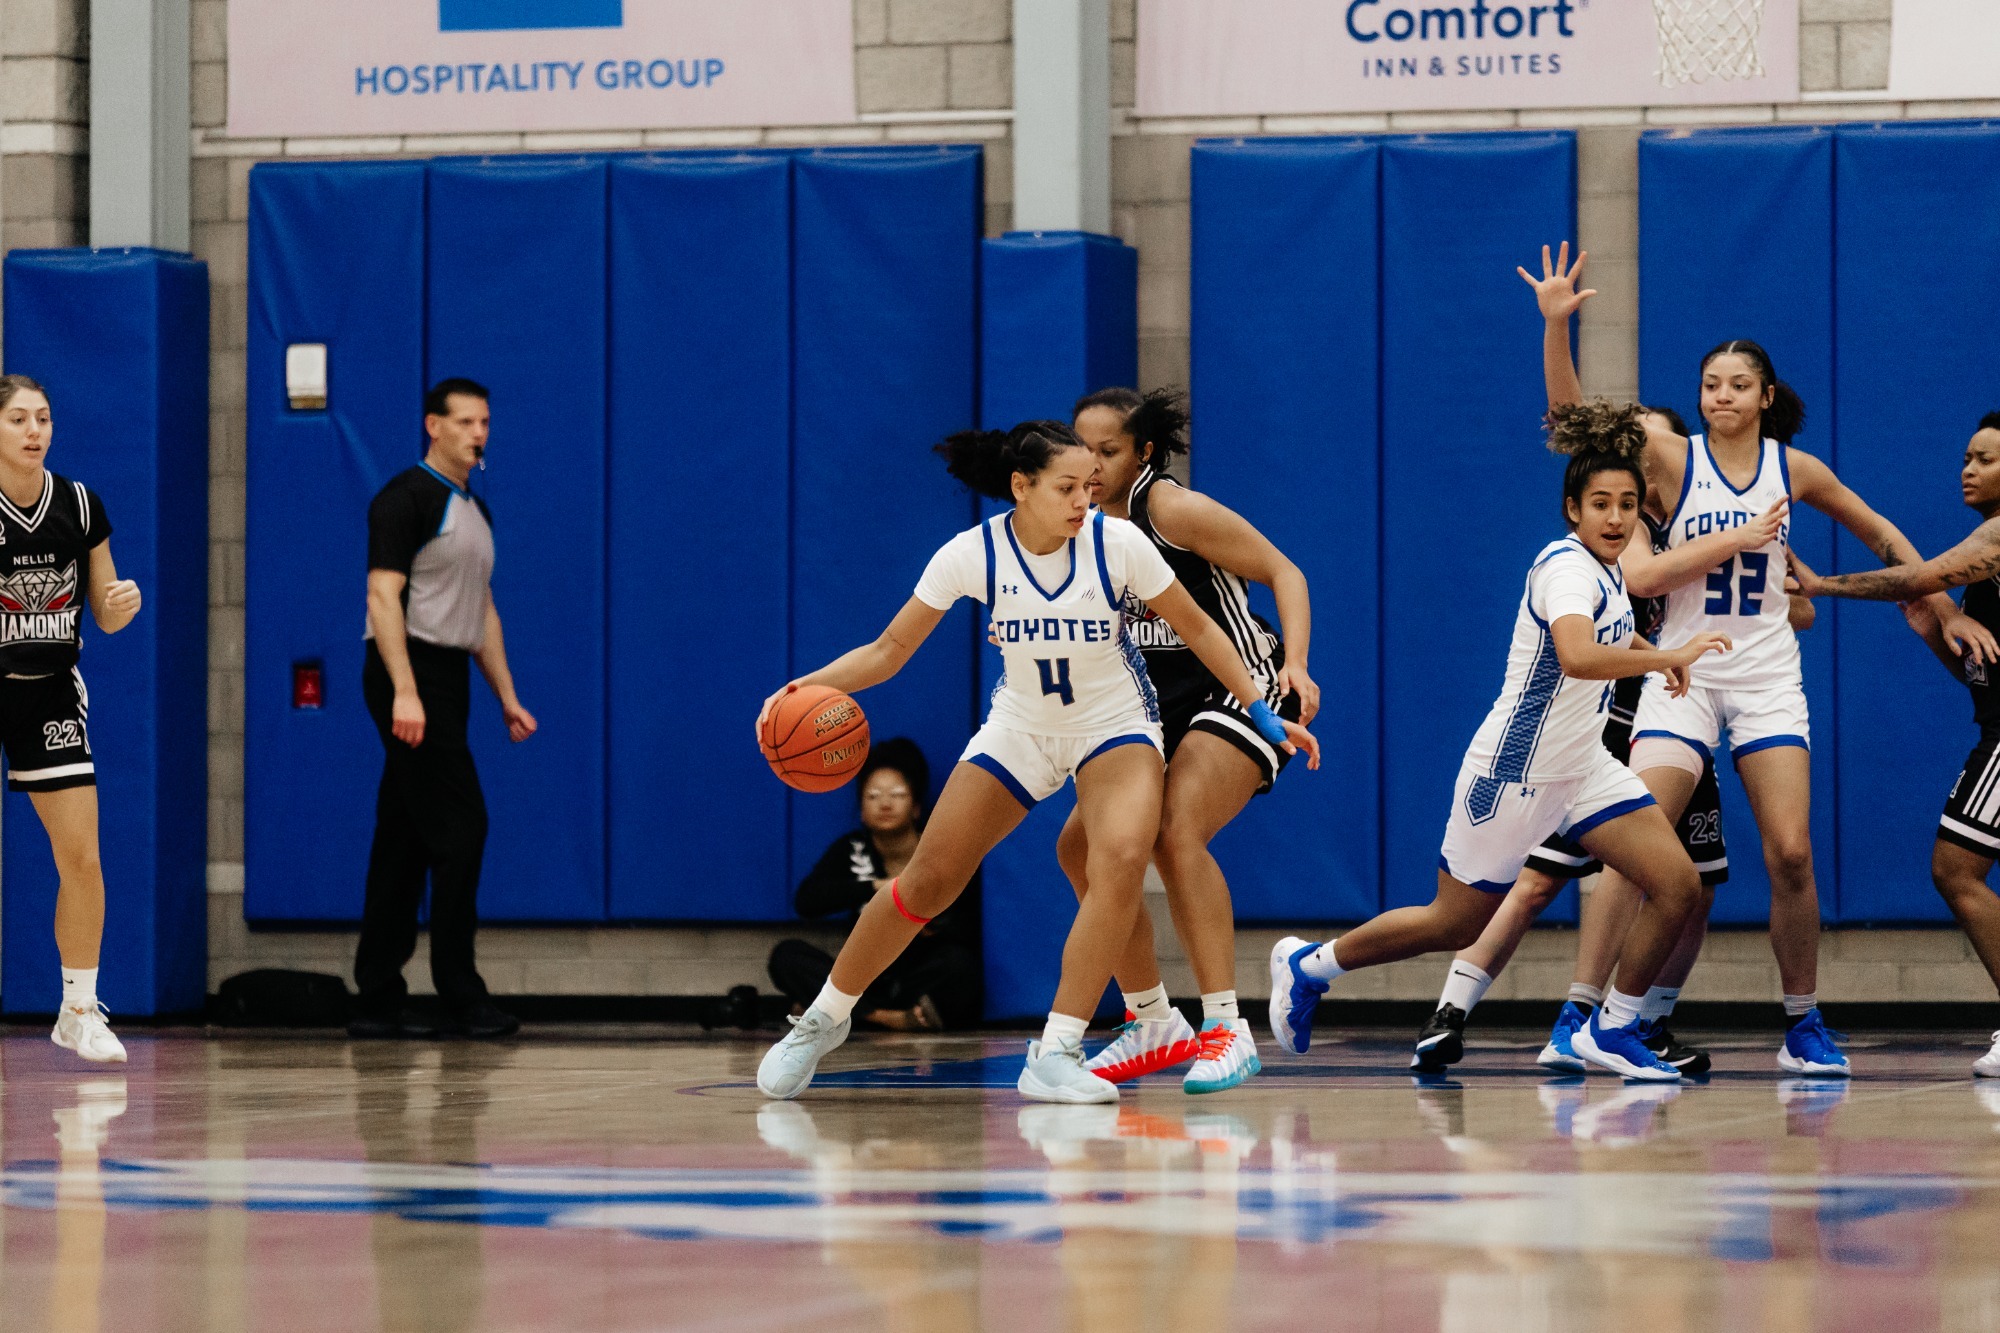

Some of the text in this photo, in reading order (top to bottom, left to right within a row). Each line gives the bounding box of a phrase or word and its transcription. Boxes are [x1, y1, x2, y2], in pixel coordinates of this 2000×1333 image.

[1346, 0, 1574, 42] Comfort
[355, 58, 724, 95] HOSPITALITY GROUP
[1363, 54, 1561, 78] INN & SUITES
[1685, 511, 1788, 547] COYOS
[13, 553, 55, 566] NELLIS
[1704, 551, 1769, 616] 32
[0, 610, 77, 642] IAMONDS
[997, 618, 1110, 642] COYOTES
[1597, 609, 1634, 645] COYO
[1034, 657, 1075, 706] 4
[43, 719, 81, 751] 22
[821, 734, 869, 768] ALDING
[1689, 809, 1720, 844] 23
